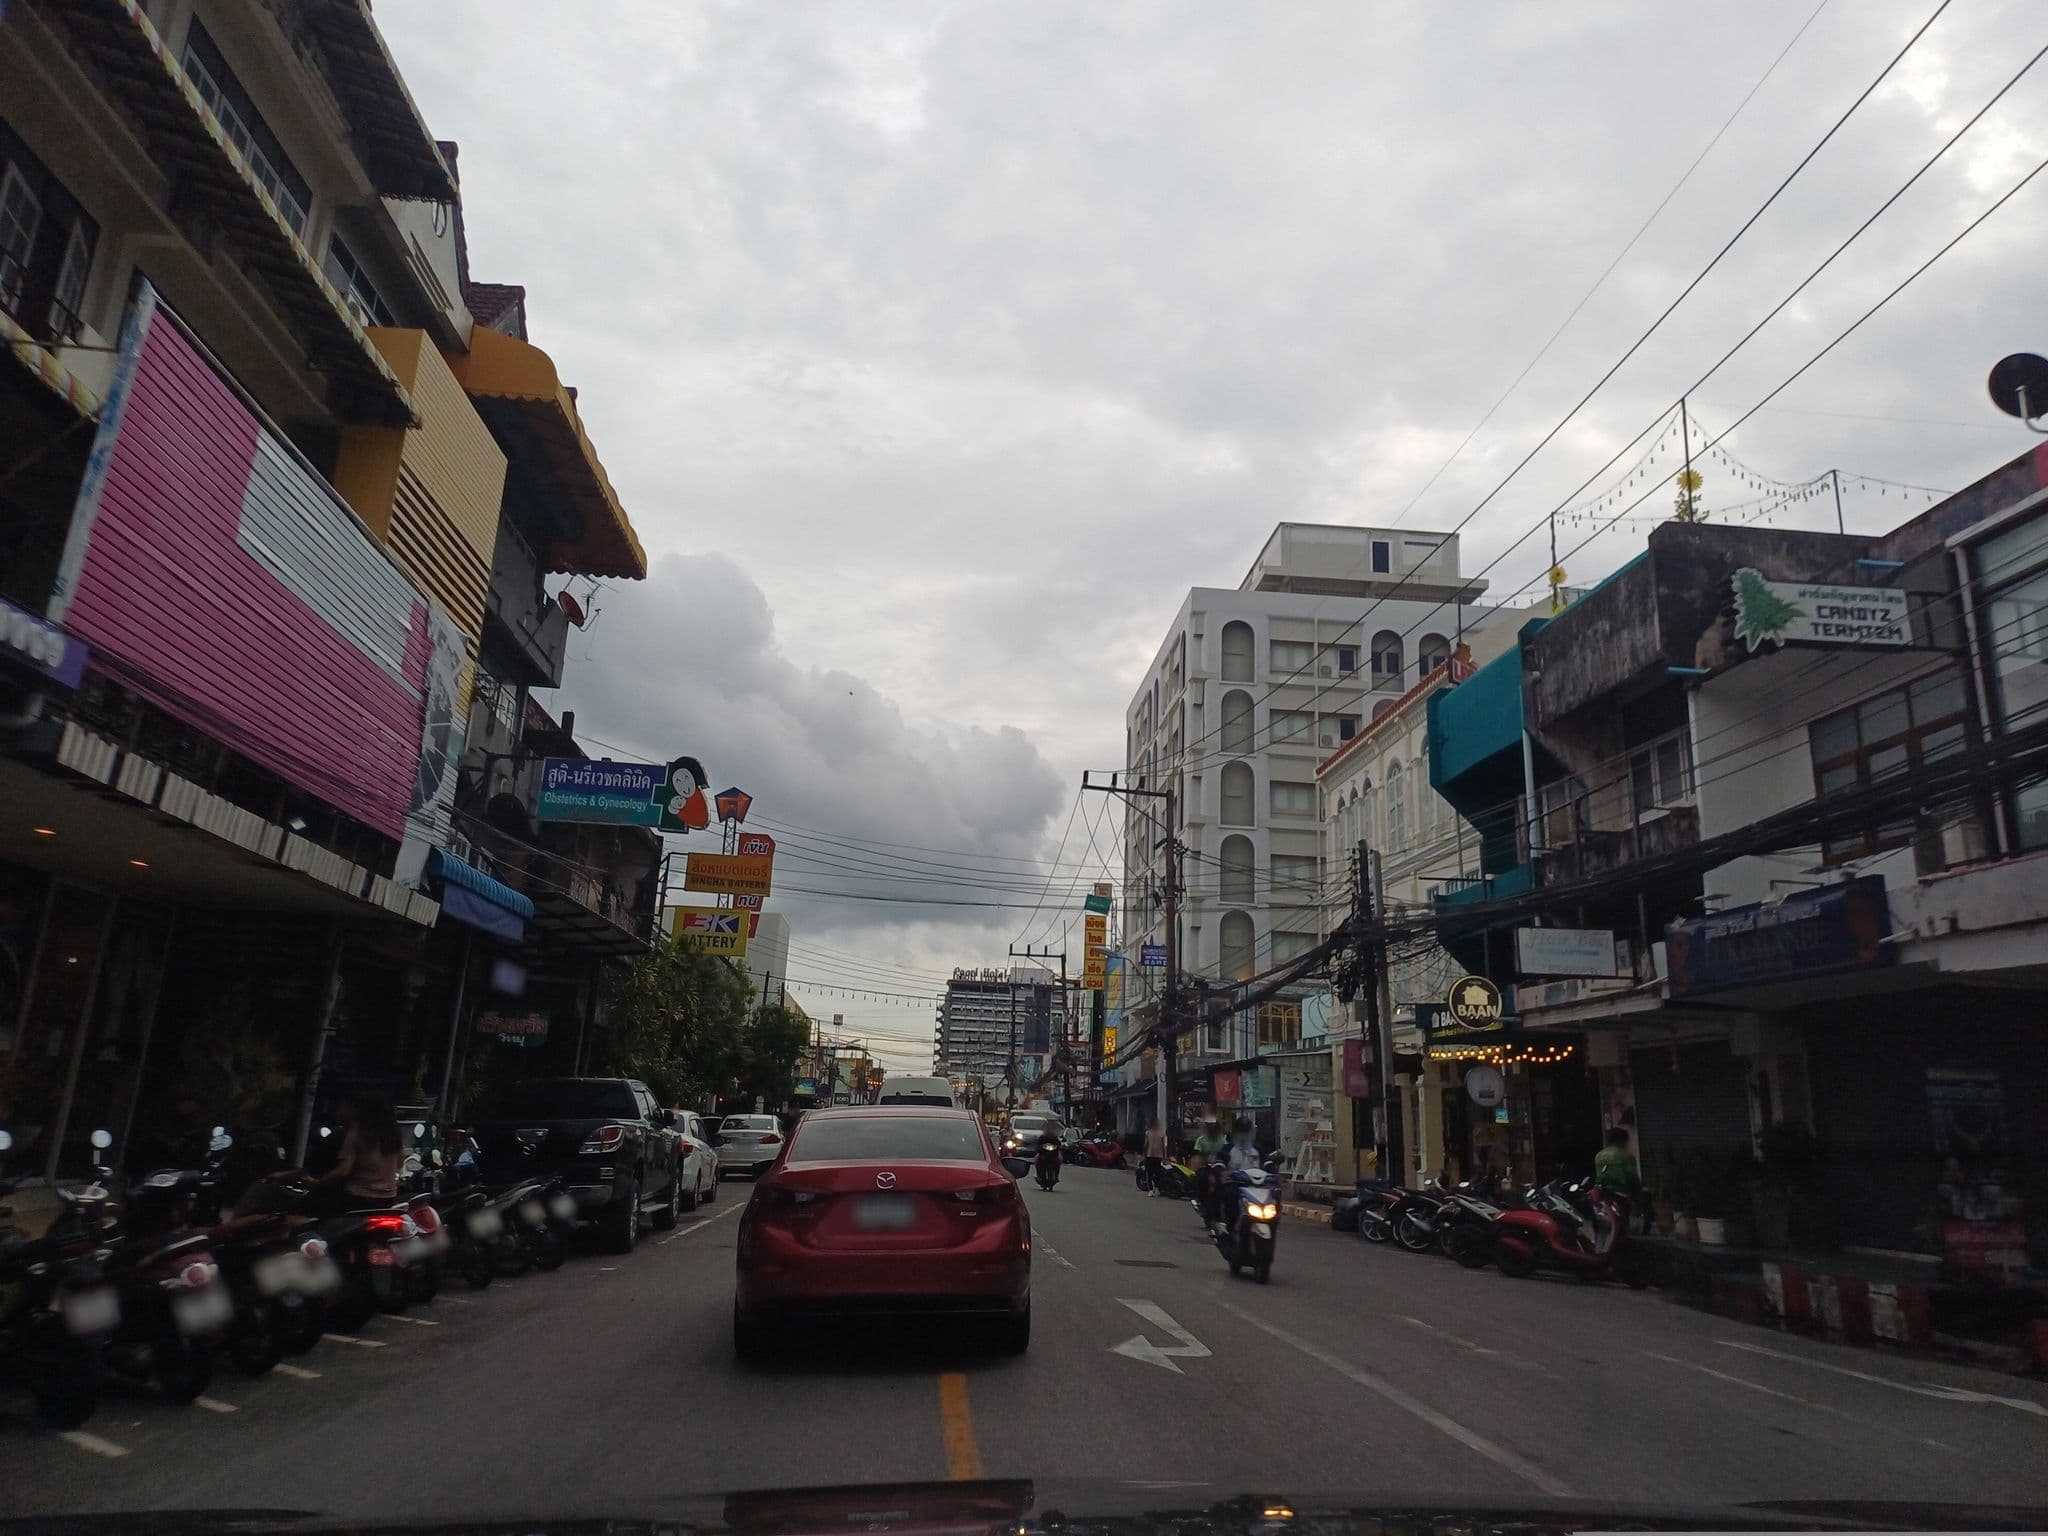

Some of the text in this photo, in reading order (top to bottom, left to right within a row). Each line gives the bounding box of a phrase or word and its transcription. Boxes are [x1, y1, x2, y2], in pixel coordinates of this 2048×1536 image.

[544, 791, 648, 813] Obstetrics & Gynecology
[728, 879, 767, 889] BATTERY
[1457, 1004, 1497, 1018] BAAN
